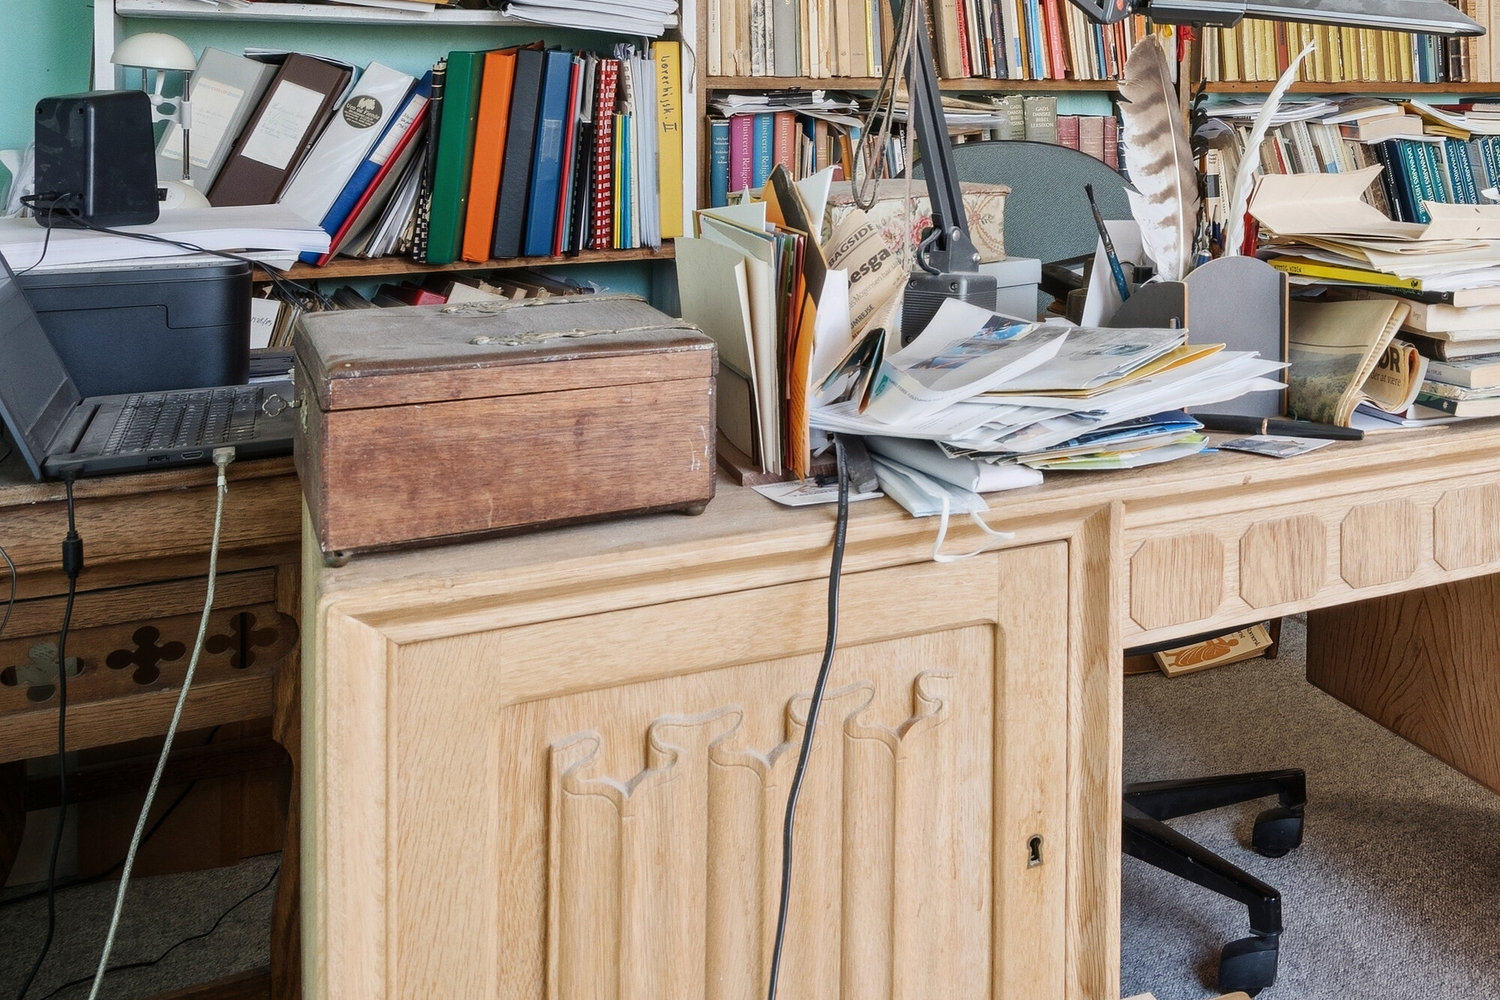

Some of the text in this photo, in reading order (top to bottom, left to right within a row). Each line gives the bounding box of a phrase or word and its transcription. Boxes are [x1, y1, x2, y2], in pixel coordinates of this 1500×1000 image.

[762, 117, 770, 153] Illustreret
[782, 117, 790, 153] Illustreret
[1407, 147, 1423, 214] DANMARKS HISTORIE
[1417, 147, 1428, 183] DANMARKS
[1448, 145, 1459, 181] DANMARKS
